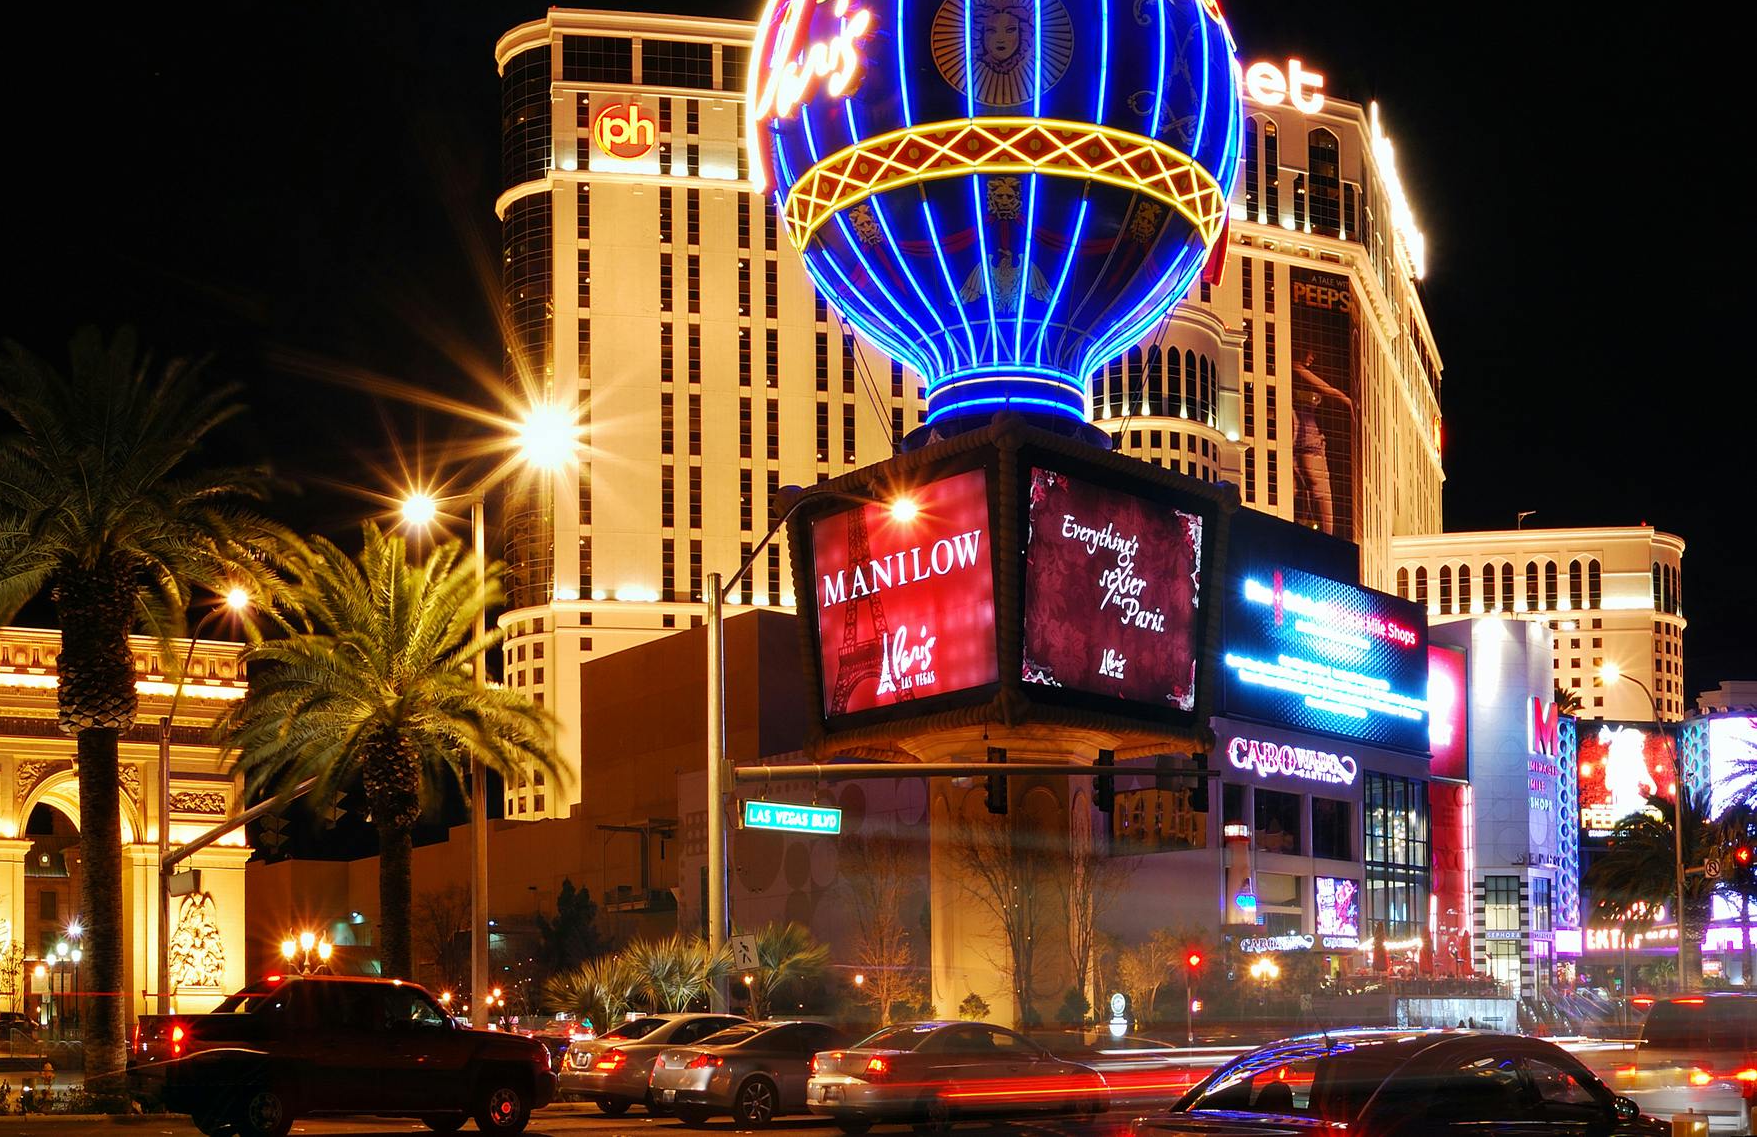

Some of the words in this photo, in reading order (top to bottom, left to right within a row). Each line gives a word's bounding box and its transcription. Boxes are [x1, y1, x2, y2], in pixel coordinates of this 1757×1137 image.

[602, 105, 655, 151] ph
[1061, 514, 1139, 567] Everything's
[822, 529, 982, 608] MANILOW
[1111, 591, 1122, 606] in
[892, 625, 937, 681] Paris
[1388, 622, 1416, 645] Shops
[901, 675, 913, 689] LAS
[915, 670, 936, 687] VEGAS
[1227, 737, 1296, 777] CABO
[749, 808, 771, 823] LAS
[775, 811, 809, 826] VEGAS
[812, 814, 837, 828] BLVD
